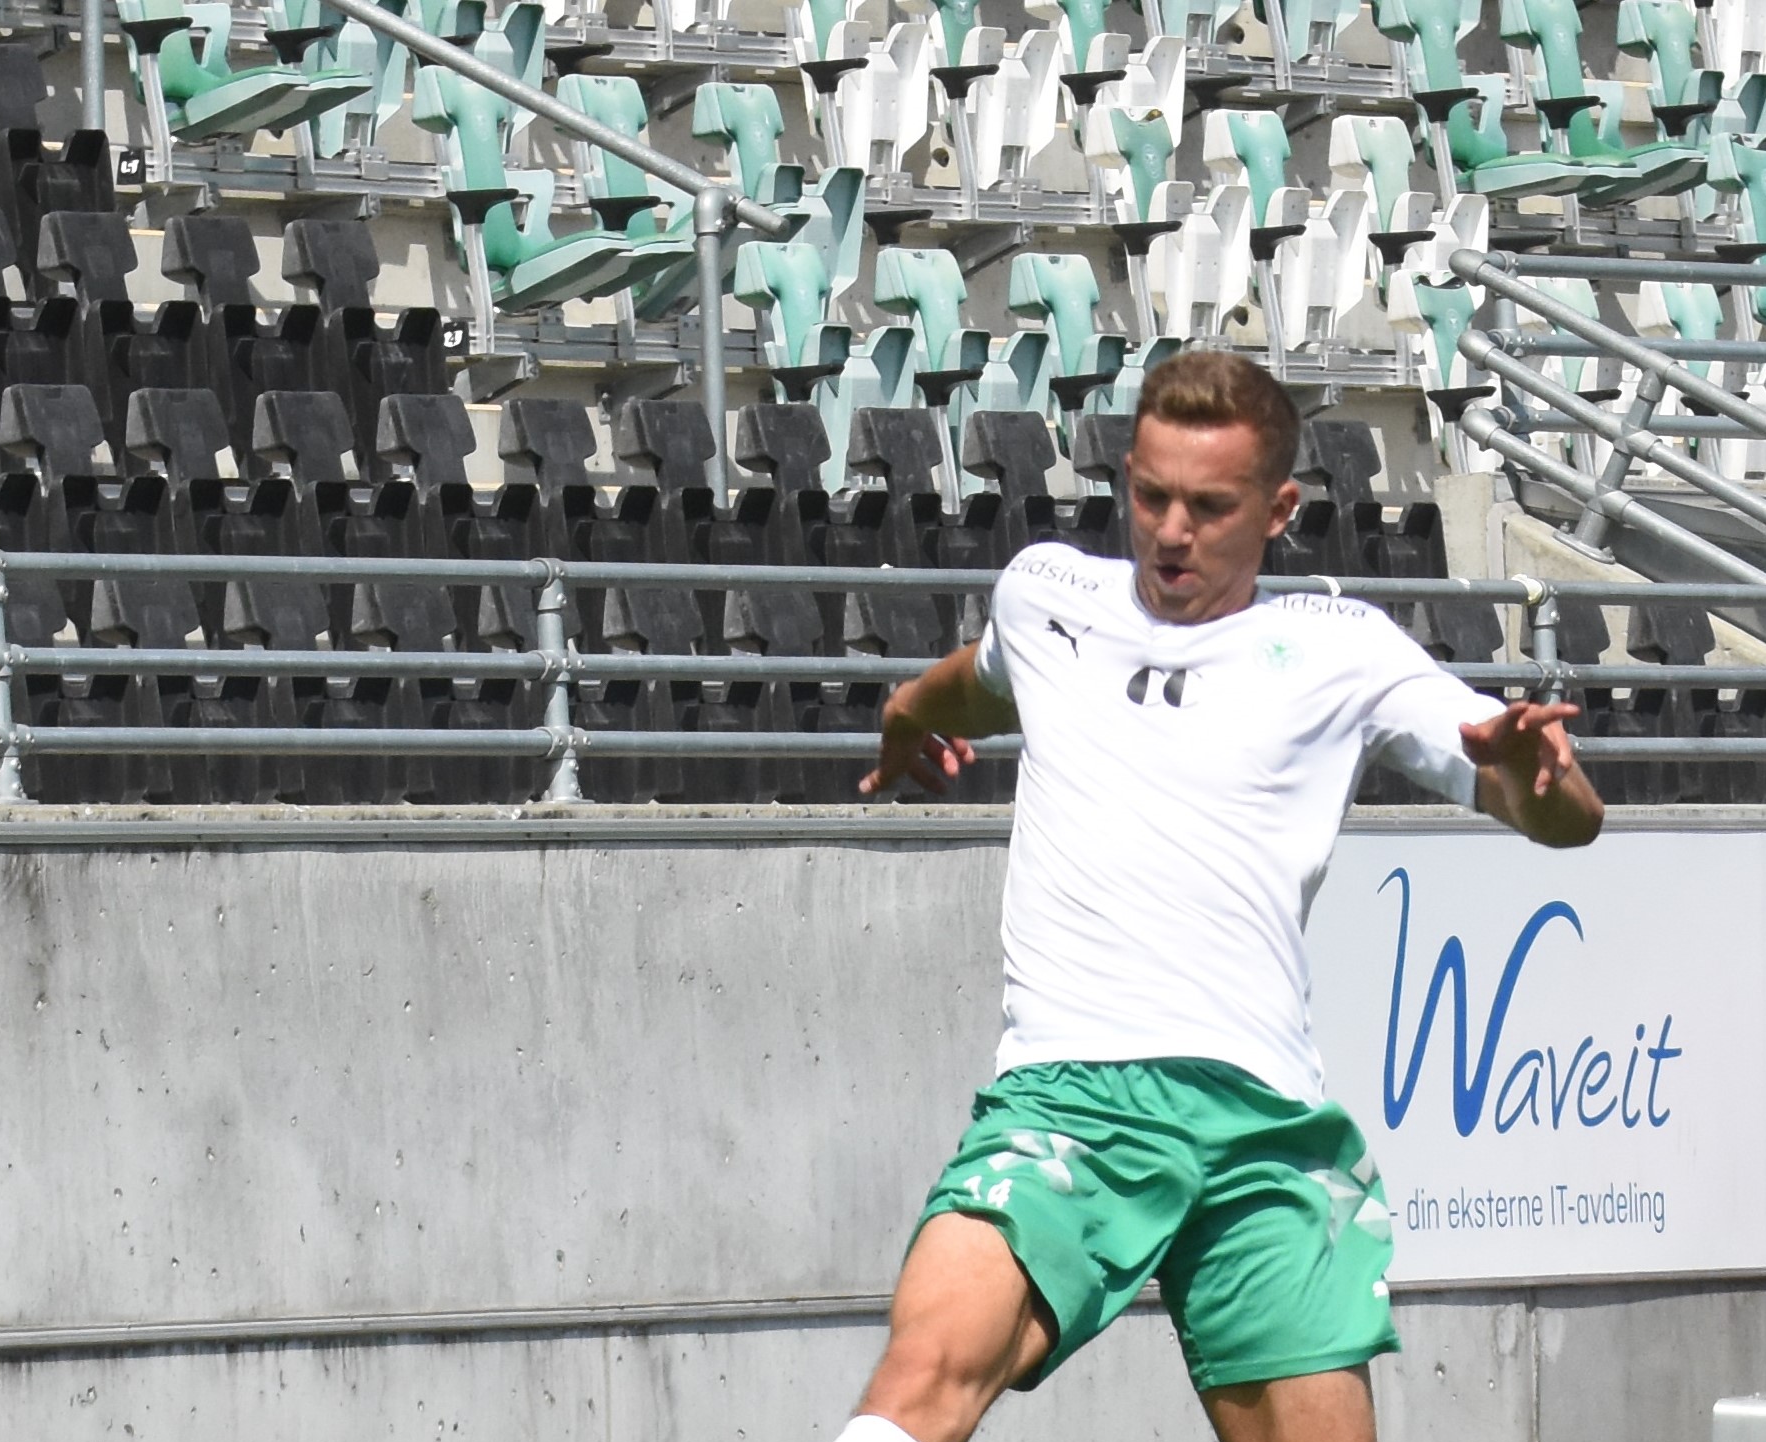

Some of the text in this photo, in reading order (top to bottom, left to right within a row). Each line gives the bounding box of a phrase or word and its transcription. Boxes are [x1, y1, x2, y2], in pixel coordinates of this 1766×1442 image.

[1377, 867, 1683, 1137] Waveit
[963, 1175, 1014, 1210] 14
[1407, 1188, 1441, 1231] din
[1447, 1187, 1544, 1229] eksterne
[1550, 1182, 1666, 1234] IT-avdeling
